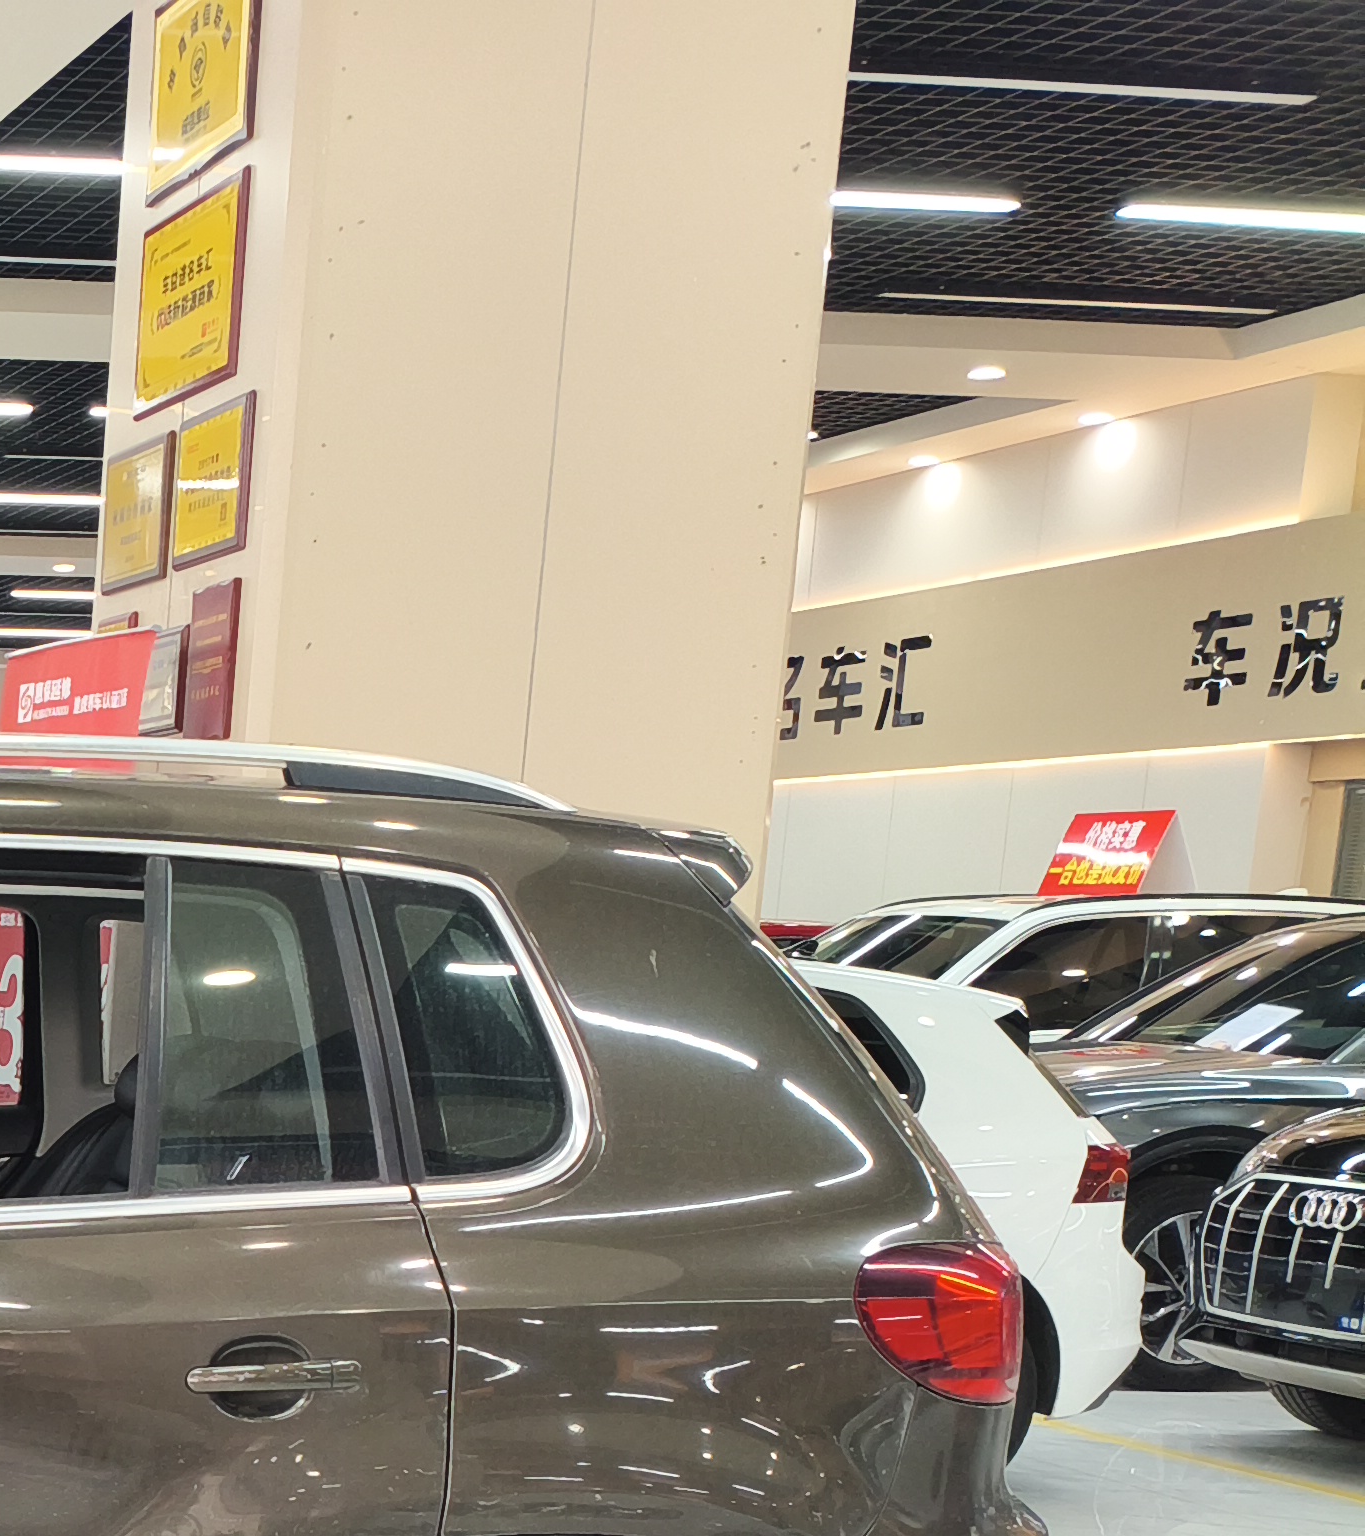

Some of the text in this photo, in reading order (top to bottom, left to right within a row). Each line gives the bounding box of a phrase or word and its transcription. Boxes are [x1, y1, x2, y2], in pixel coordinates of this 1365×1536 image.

[1179, 595, 1365, 706] 车况
[1083, 820, 1146, 851] 价格实惠
